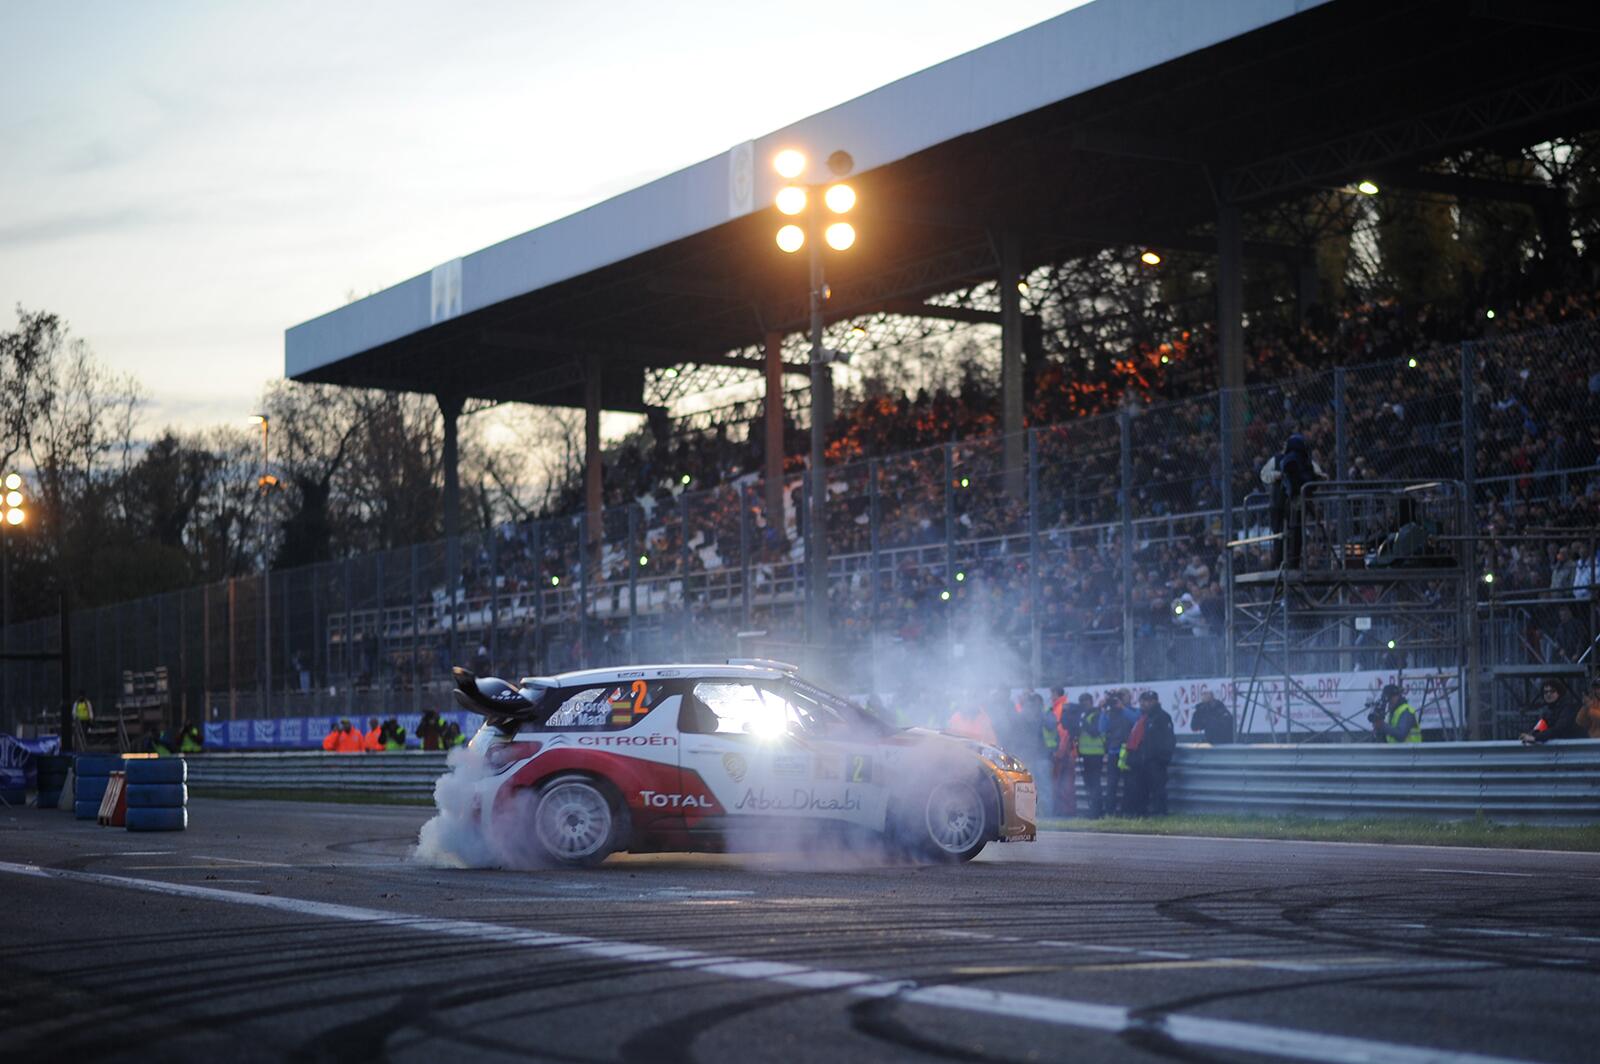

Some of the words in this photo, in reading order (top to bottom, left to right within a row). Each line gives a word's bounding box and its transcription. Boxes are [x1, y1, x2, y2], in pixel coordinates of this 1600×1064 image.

[632, 678, 649, 714] 2
[1318, 678, 1341, 698] DRY
[852, 755, 864, 784] 2
[640, 790, 713, 808] TOTAL
[735, 788, 786, 811] Abu
[790, 787, 862, 811] Dhabi
